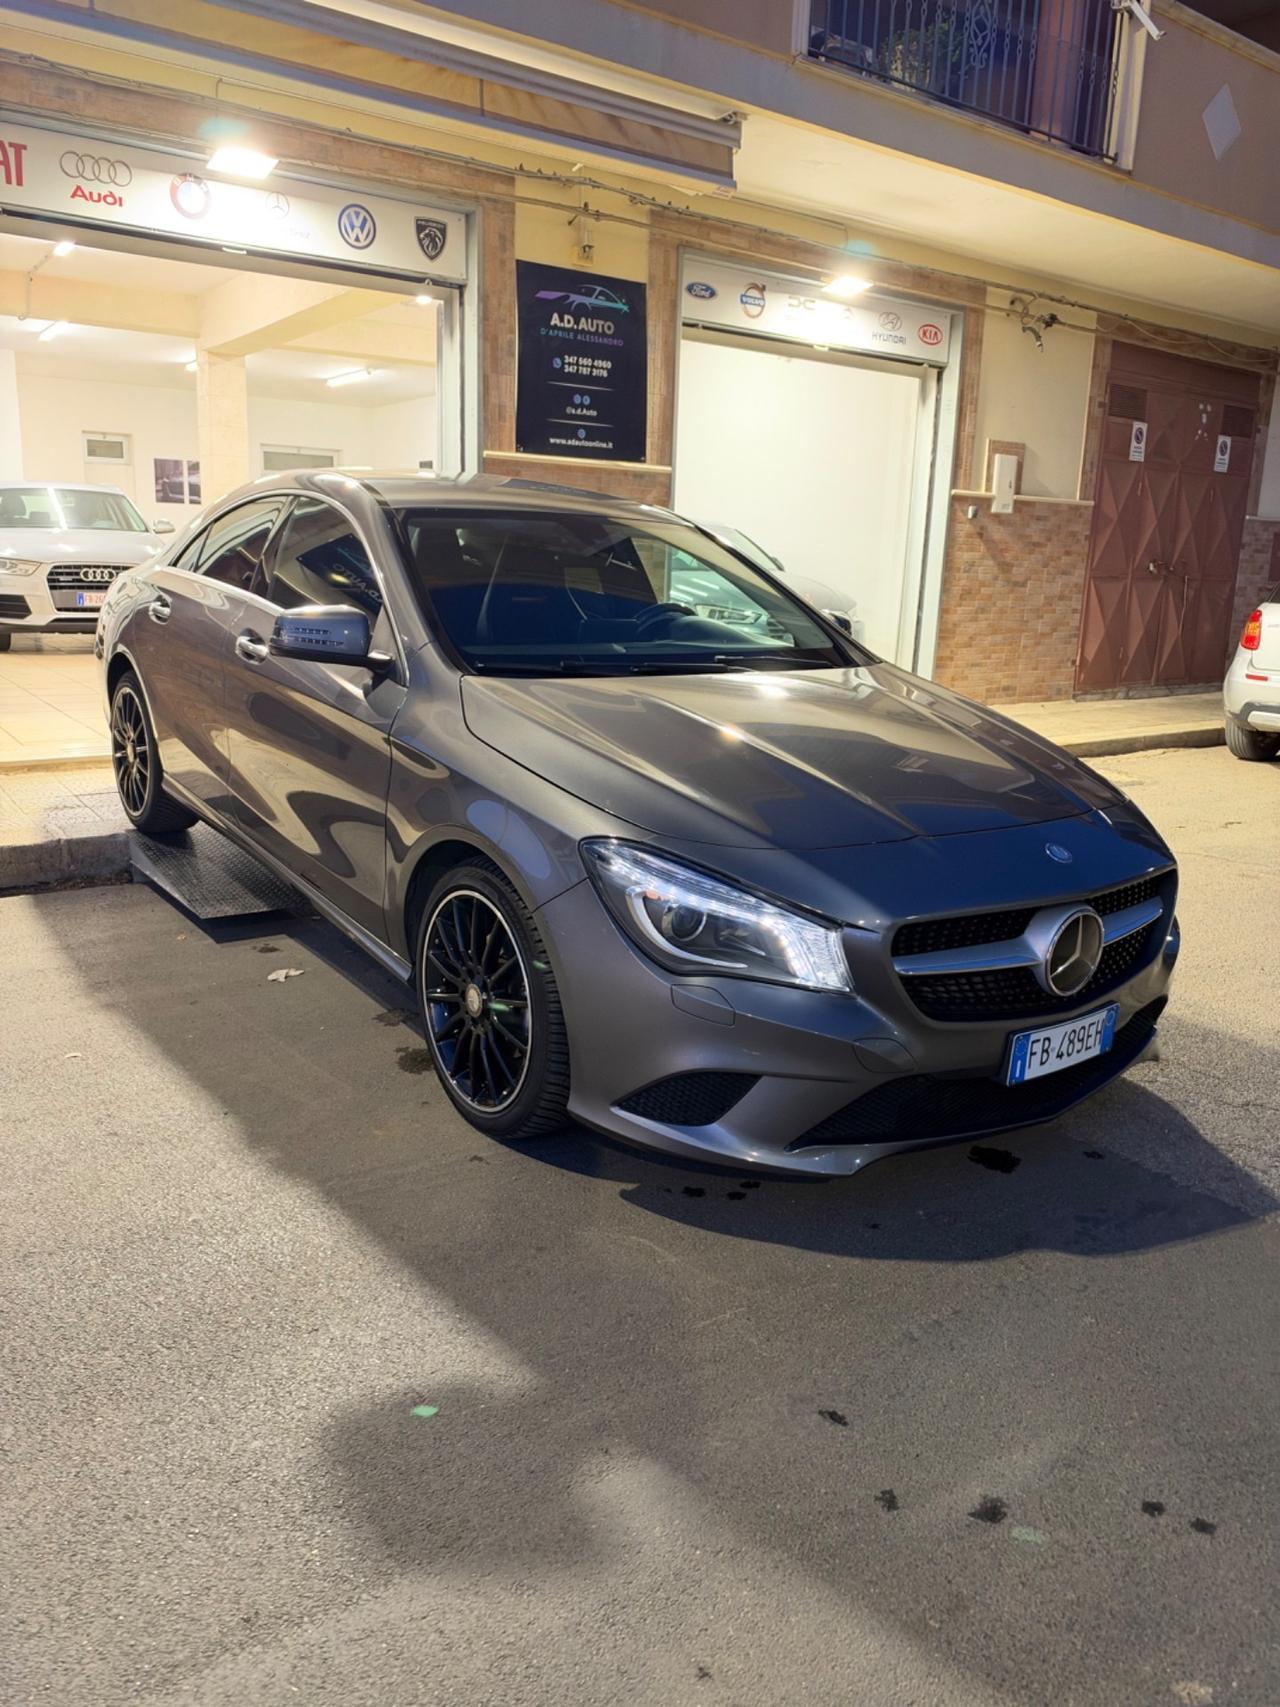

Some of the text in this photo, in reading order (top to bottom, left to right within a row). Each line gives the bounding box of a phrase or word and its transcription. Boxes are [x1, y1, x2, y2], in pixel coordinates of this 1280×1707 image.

[70, 184, 123, 207] Audi
[690, 284, 712, 298] Ford
[742, 296, 765, 306] VOLVO
[577, 333, 624, 347] ALESSANDRO
[871, 330, 907, 345] HYUNDAI
[921, 327, 939, 342] KIA
[564, 354, 577, 364] 347
[564, 364, 577, 373] 347
[1027, 1018, 1105, 1070] FB 489EH
